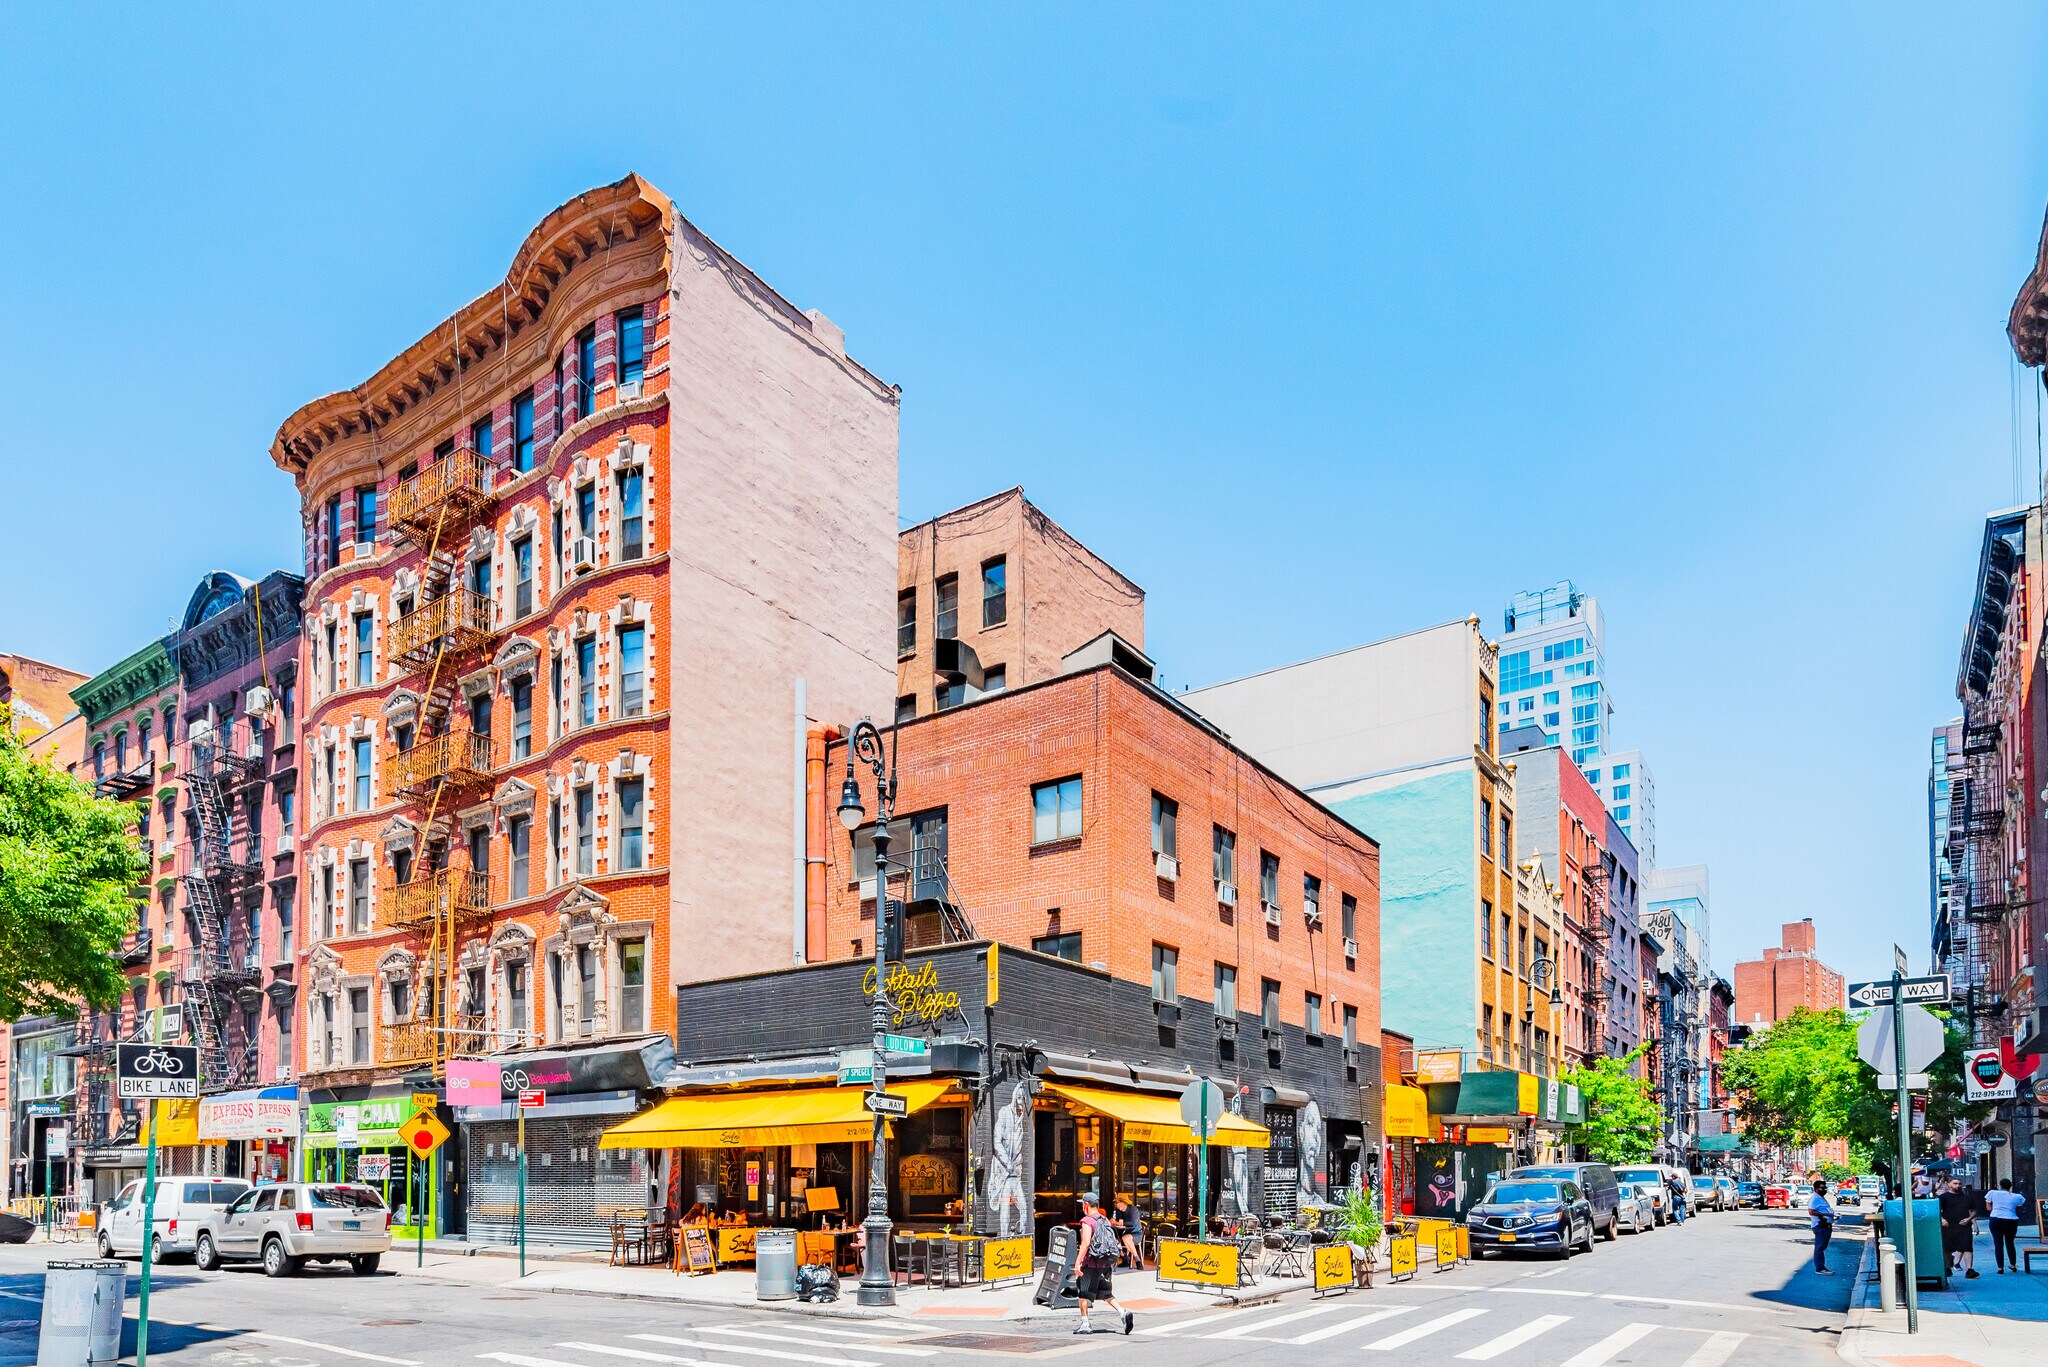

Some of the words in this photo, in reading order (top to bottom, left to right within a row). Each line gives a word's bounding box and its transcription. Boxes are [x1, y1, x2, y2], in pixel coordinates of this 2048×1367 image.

[863, 961, 938, 994] Ccktails
[1861, 988, 1890, 999] ONE
[1907, 984, 1939, 996] WAY
[893, 990, 960, 1024] Pizza
[886, 1039, 914, 1051] LUDLOW
[529, 1071, 572, 1085] Babeland
[123, 1080, 152, 1093] BIKE
[160, 1081, 193, 1093] LANE
[1971, 1089, 2011, 1098] 212-979-9211
[259, 1103, 291, 1117] EXPRESS
[869, 1097, 883, 1107] ONE
[888, 1099, 902, 1109] WAY
[213, 1102, 254, 1121] EXPRESS
[1175, 1250, 1220, 1275] Serafina
